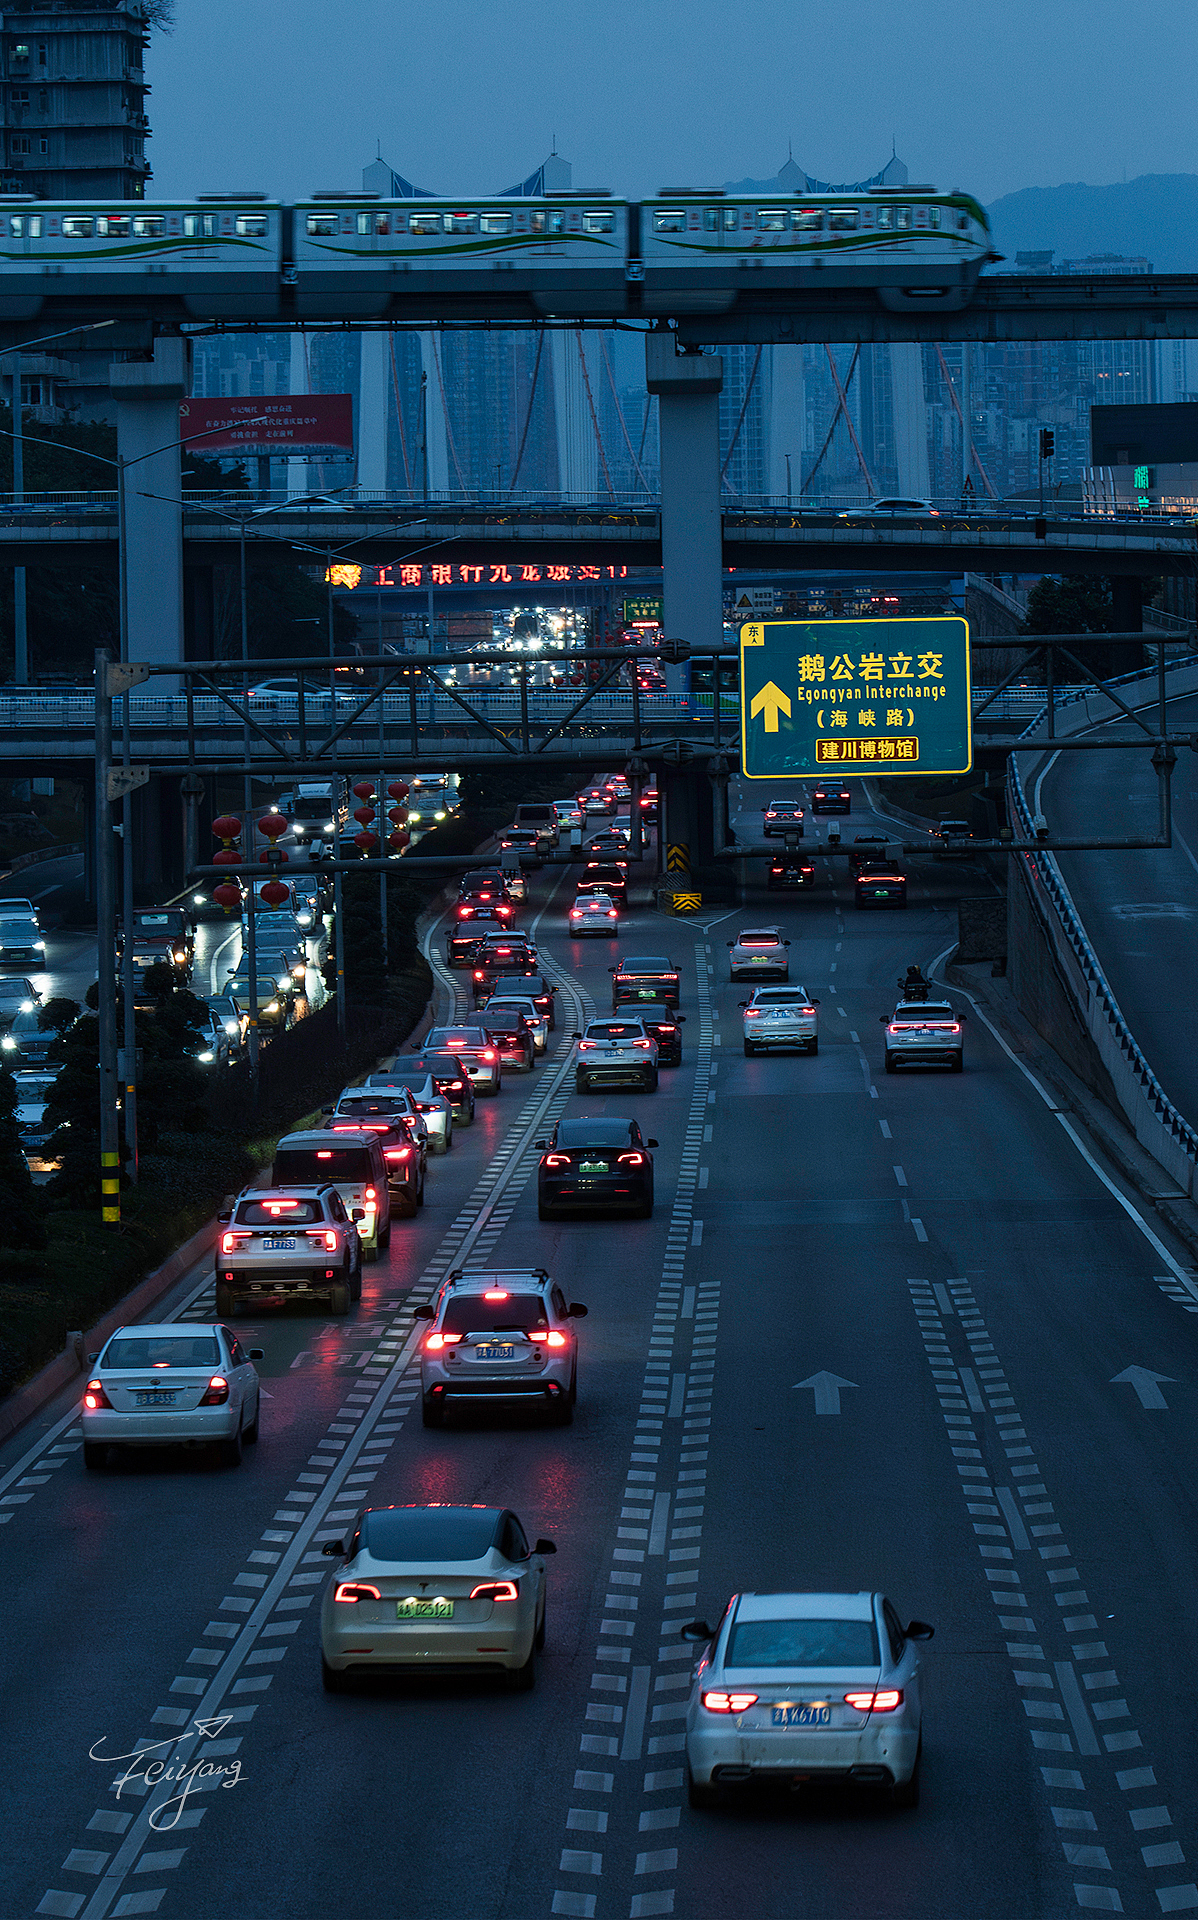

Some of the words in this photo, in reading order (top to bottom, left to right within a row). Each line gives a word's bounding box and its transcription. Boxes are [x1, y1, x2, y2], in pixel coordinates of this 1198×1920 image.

[748, 626, 760, 637] 东
[798, 651, 945, 682] 鹅公岩立交
[797, 685, 862, 705] Egongyan
[865, 684, 947, 702] Interchange
[821, 740, 915, 760] 建川博物馆
